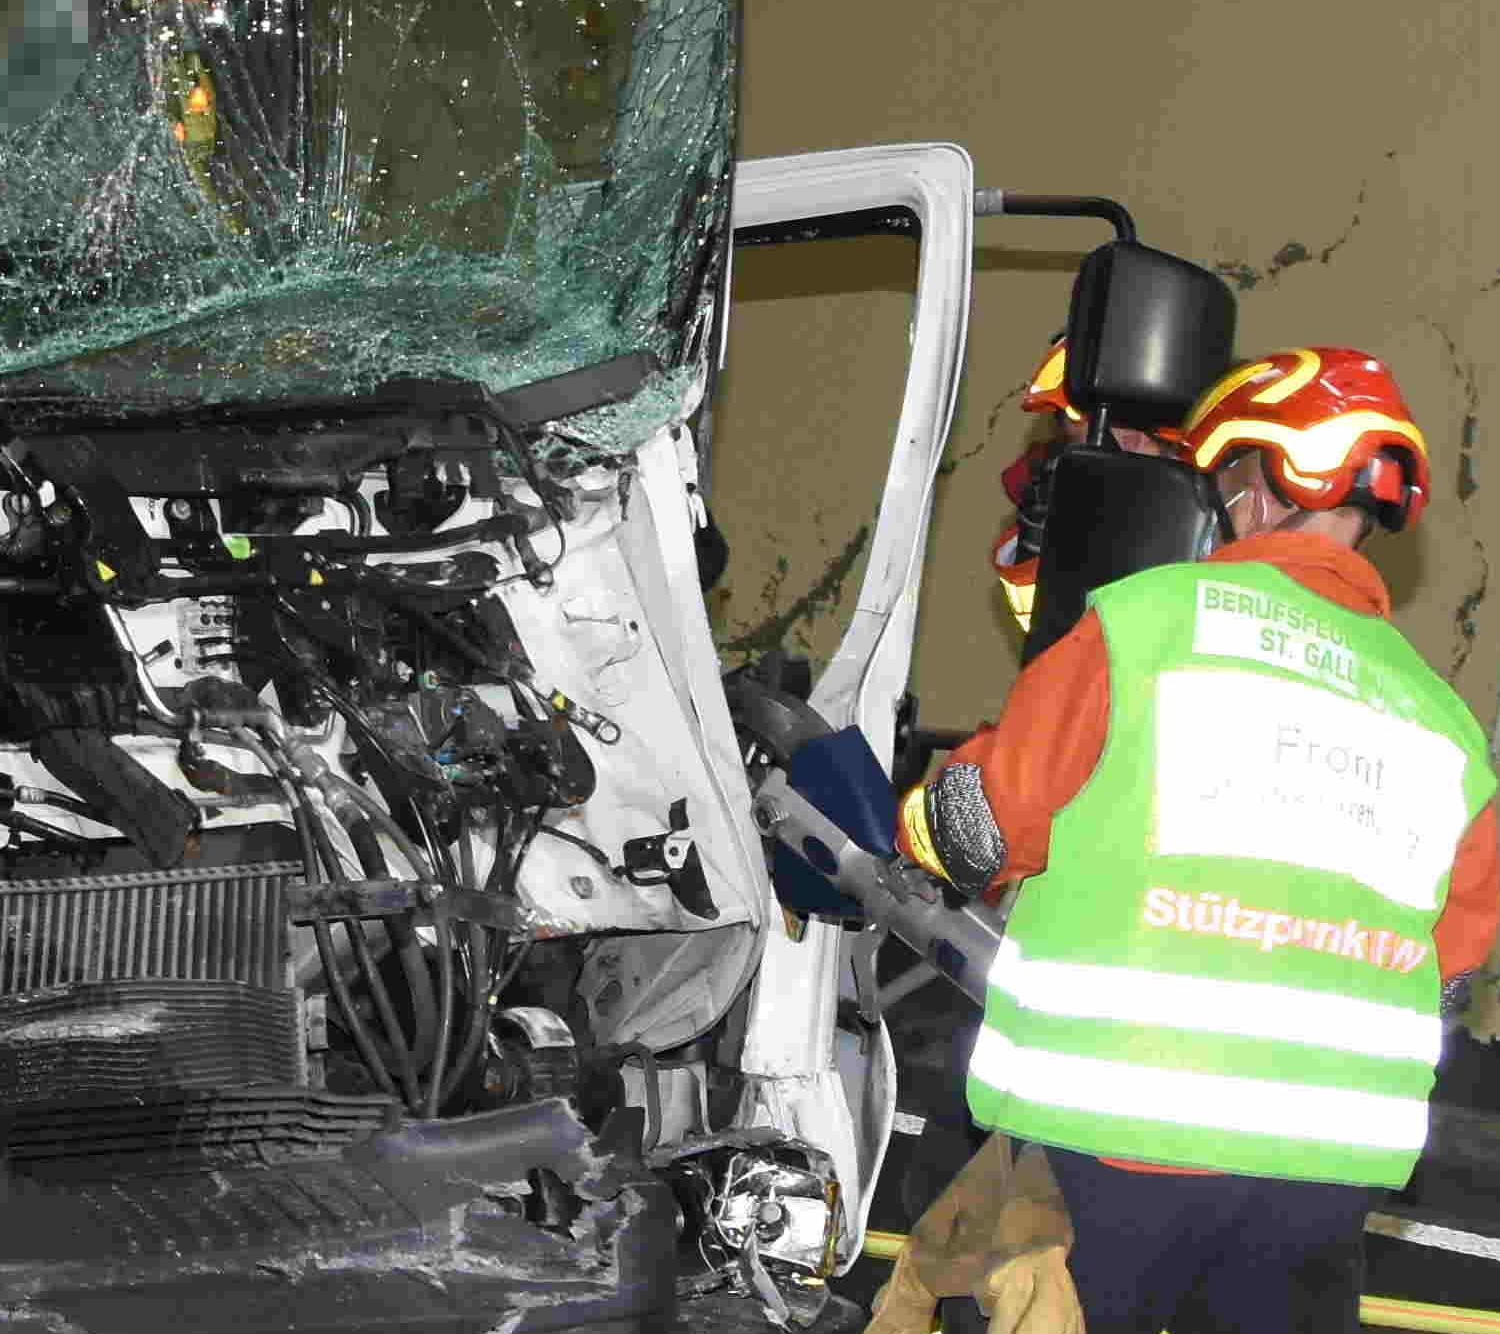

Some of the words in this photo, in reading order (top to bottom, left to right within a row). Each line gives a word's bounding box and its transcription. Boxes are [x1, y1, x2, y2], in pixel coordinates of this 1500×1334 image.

[1260, 627, 1294, 659] ST.
[1304, 642, 1355, 684] GALL
[1273, 722, 1385, 792] Front
[1142, 886, 1370, 961] Stützpunk
